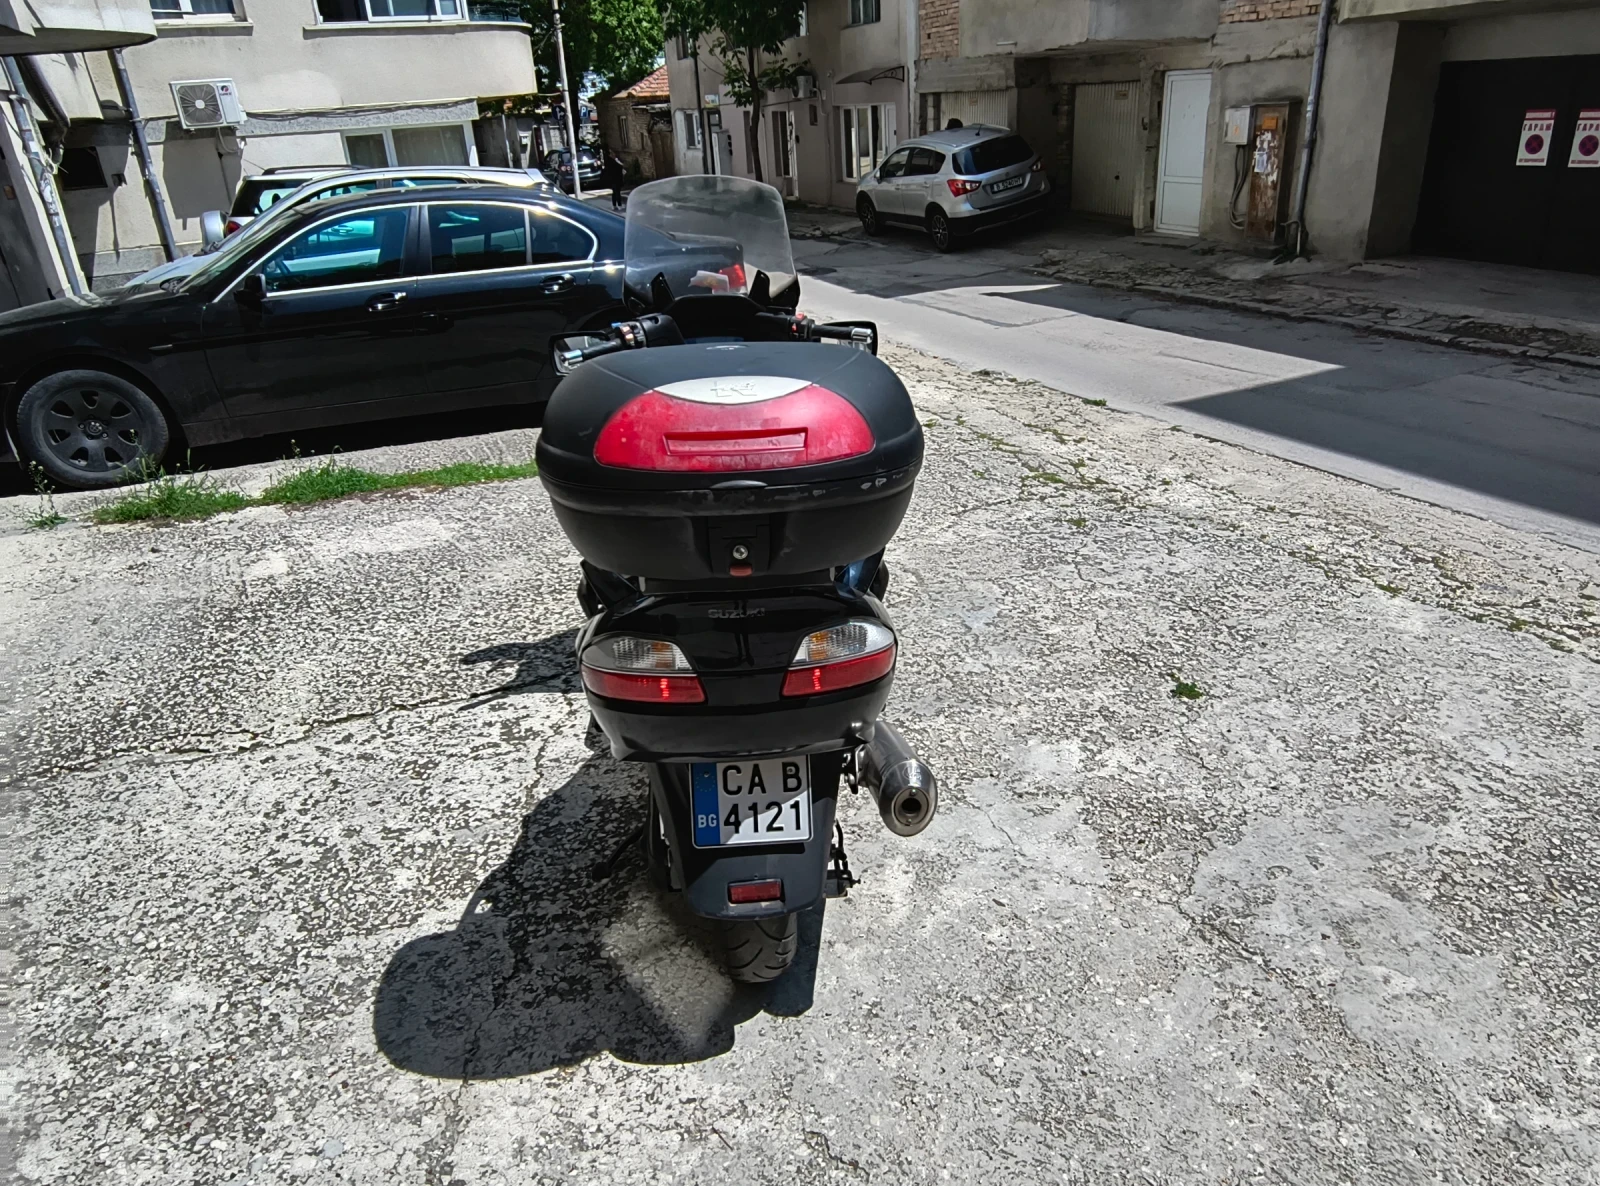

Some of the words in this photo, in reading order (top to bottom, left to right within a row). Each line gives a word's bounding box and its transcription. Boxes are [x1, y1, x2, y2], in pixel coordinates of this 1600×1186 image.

[581, 106, 587, 117] P
[1577, 123, 1600, 132] ГАРА
[698, 814, 717, 828] BG
[723, 800, 803, 834] 4121
